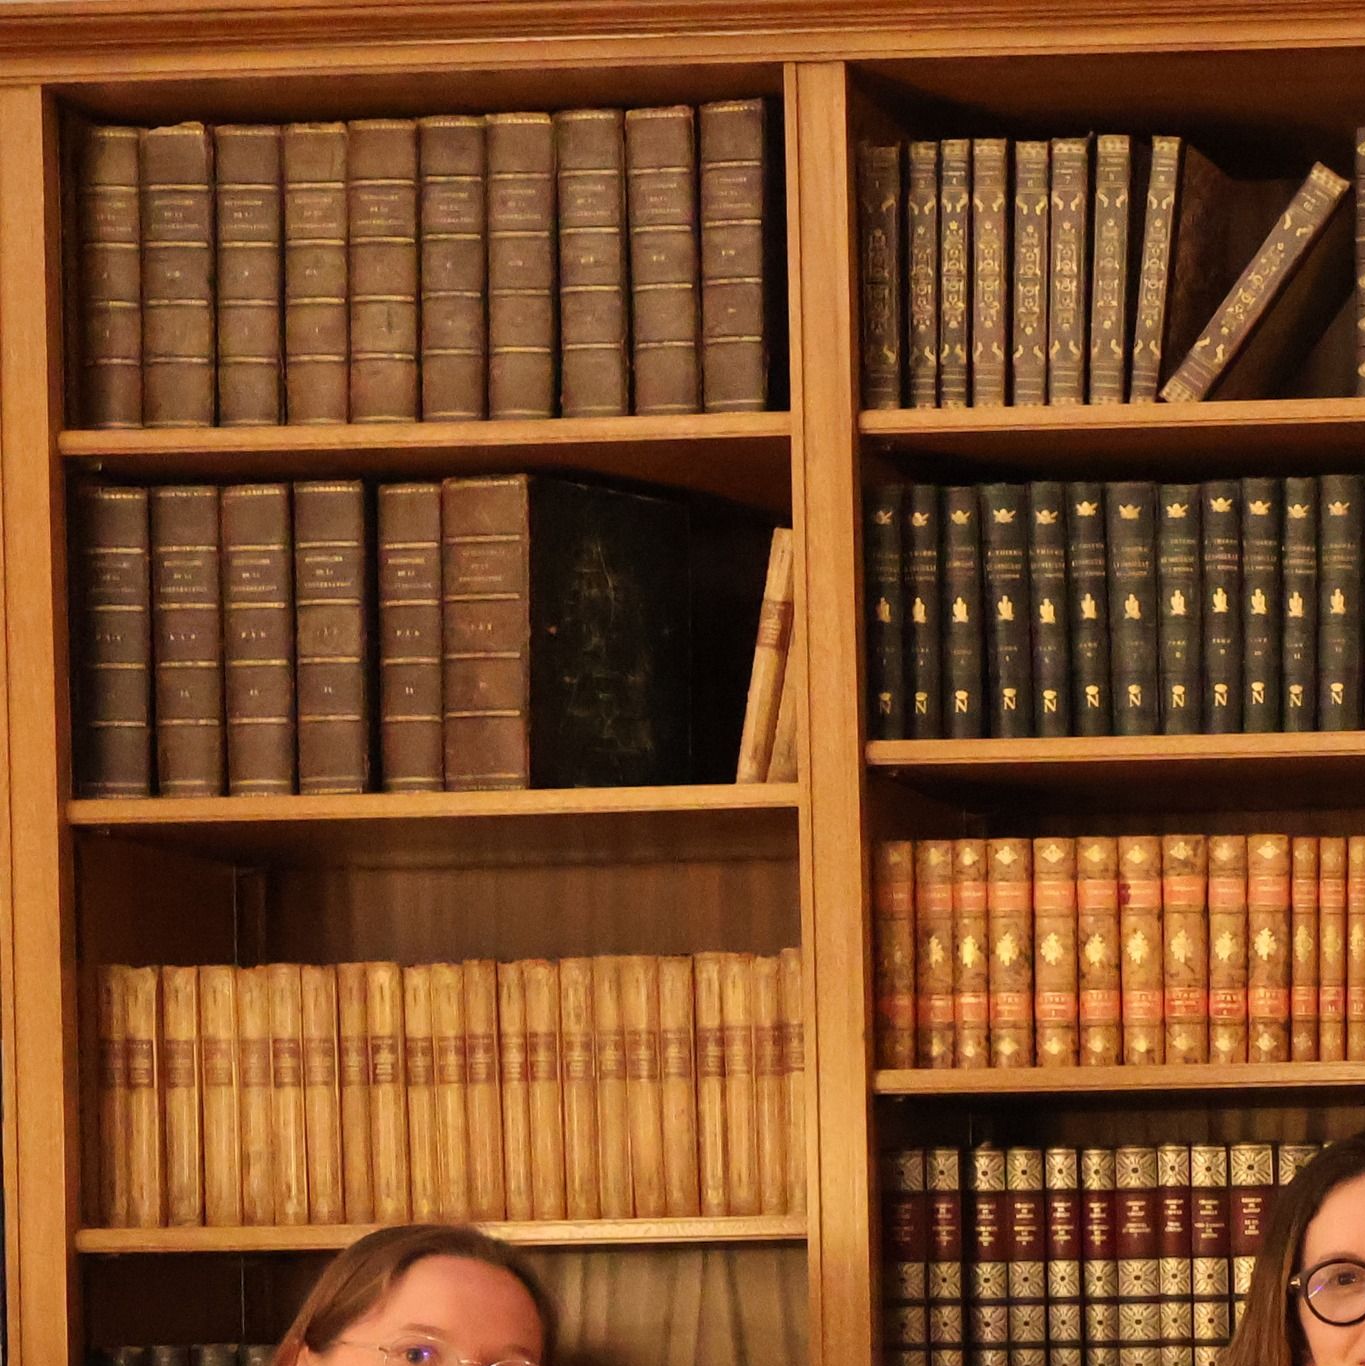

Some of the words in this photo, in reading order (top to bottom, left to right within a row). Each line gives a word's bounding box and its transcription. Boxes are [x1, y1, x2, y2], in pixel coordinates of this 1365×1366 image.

[1004, 697, 1016, 710] N
[1087, 694, 1099, 708] N
[1129, 694, 1141, 708] N
[1172, 693, 1185, 708] N
[1215, 693, 1227, 707] N
[1252, 691, 1264, 705] N
[1290, 693, 1302, 707] N
[1331, 691, 1343, 705] N
[880, 700, 891, 714] N
[915, 700, 927, 714] N
[955, 699, 967, 713] N
[1044, 699, 1056, 712] N
